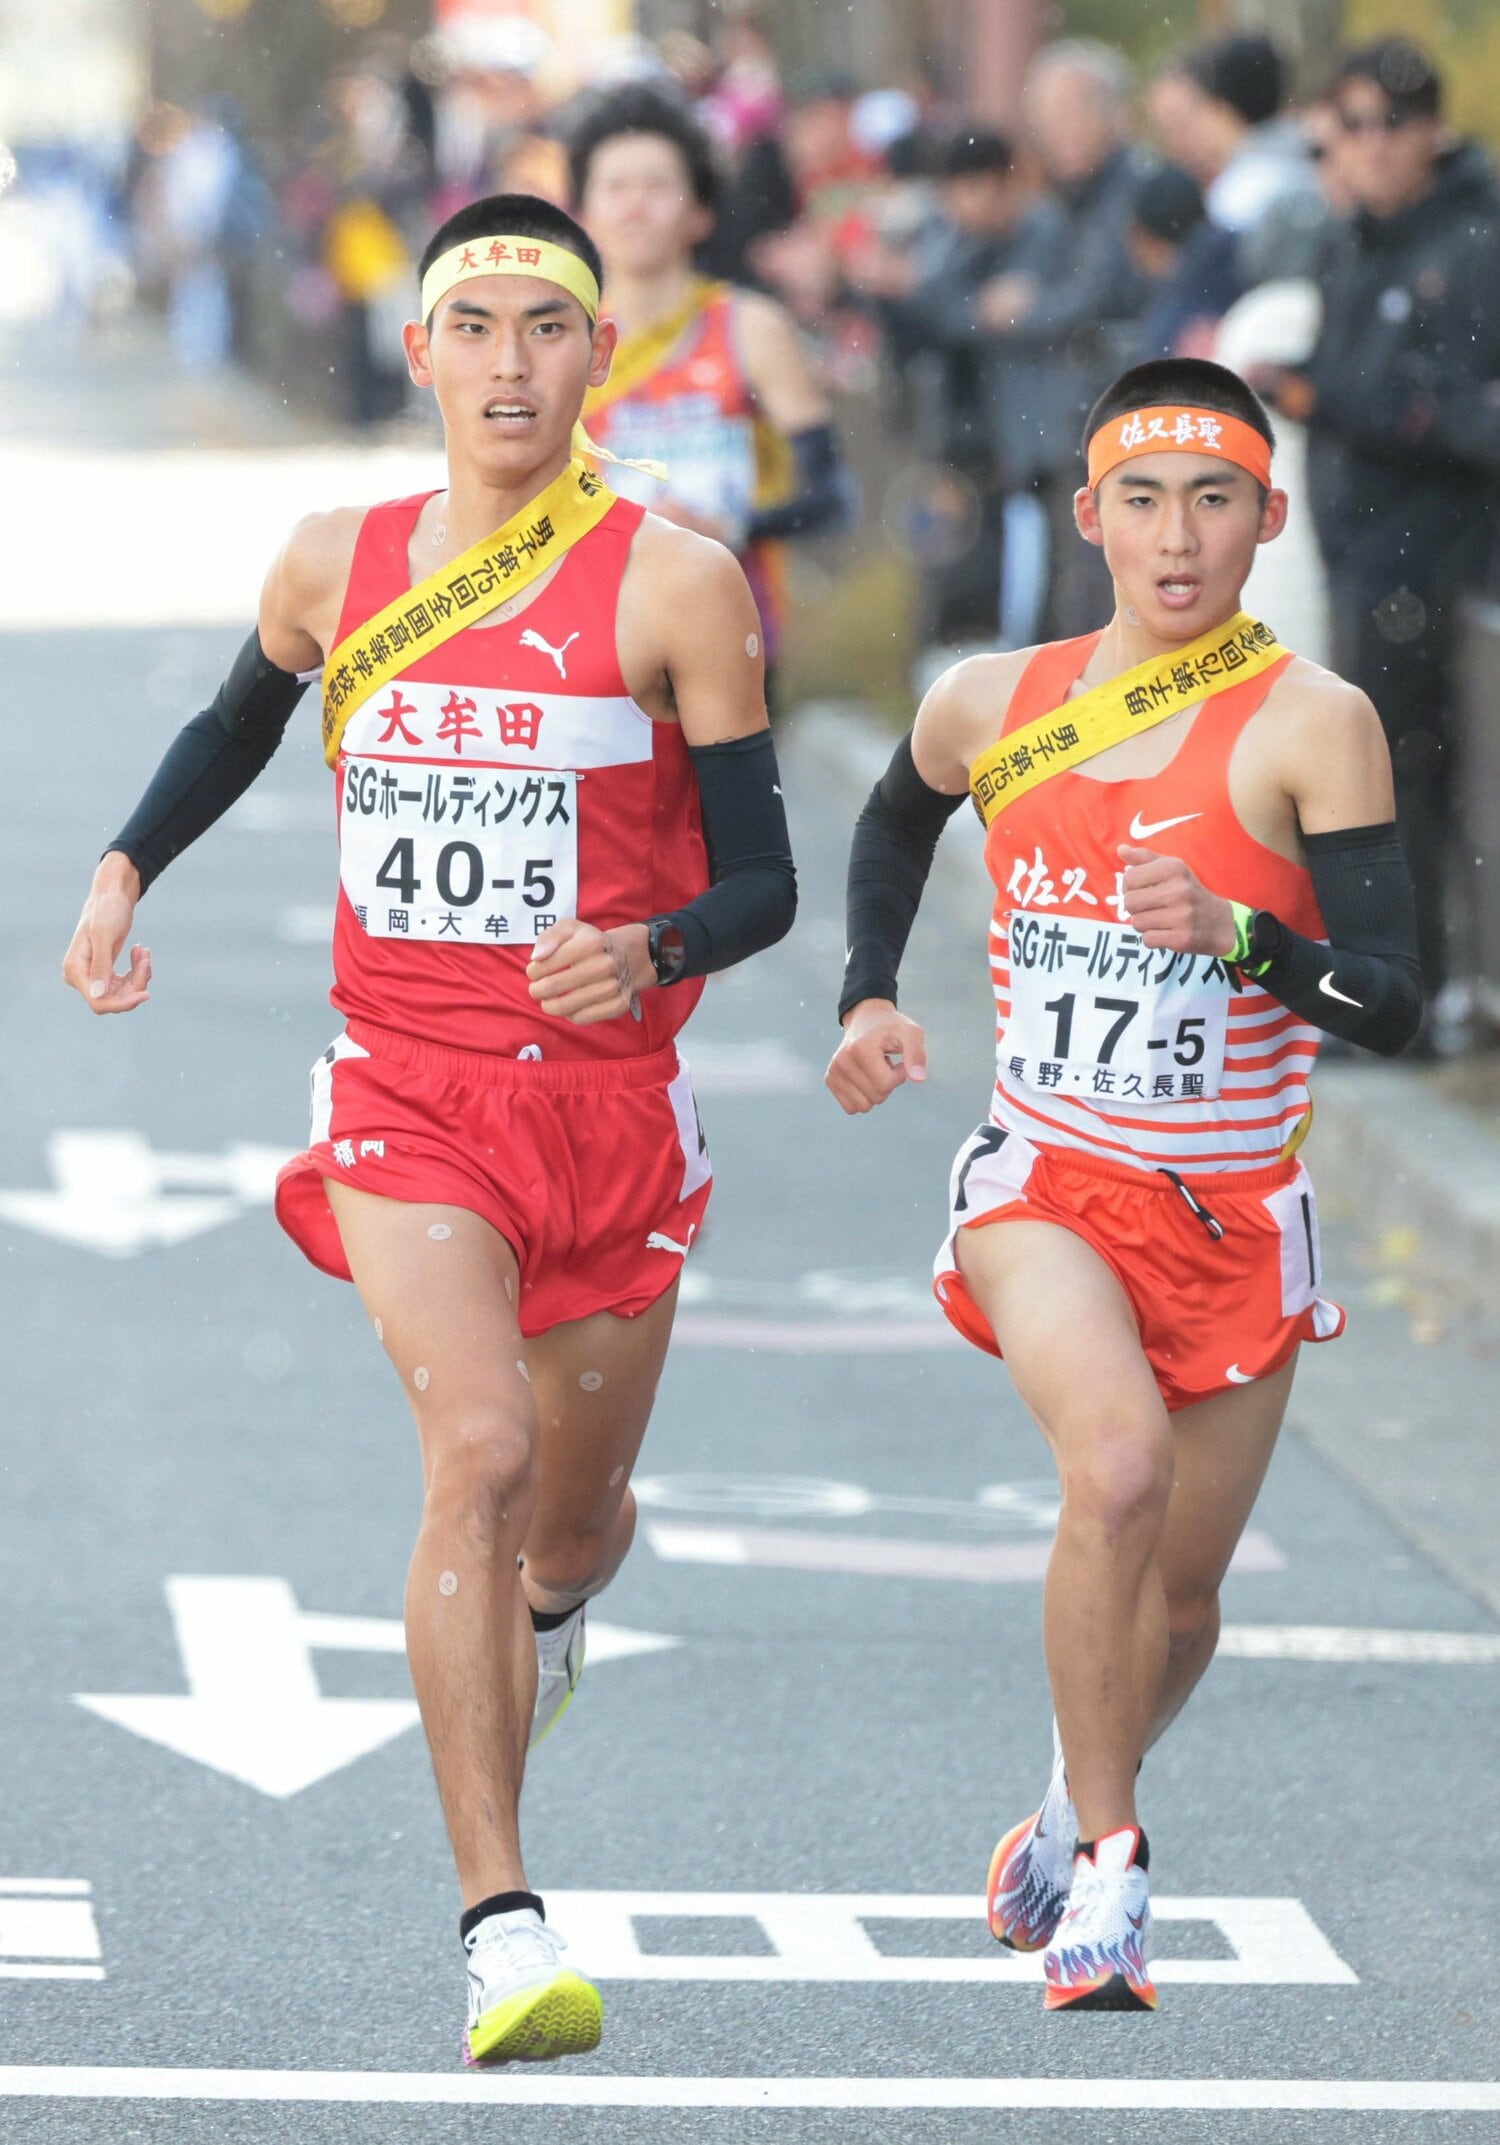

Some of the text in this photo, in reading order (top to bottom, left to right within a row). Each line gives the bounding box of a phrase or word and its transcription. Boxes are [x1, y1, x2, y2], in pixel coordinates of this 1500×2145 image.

[457, 240, 541, 273] 大牟田
[1119, 412, 1223, 450] 佐久長聖
[377, 690, 544, 754] 大牟田
[346, 765, 571, 827] SGホールディングス
[969, 723, 1080, 831] 男子第75回
[376, 838, 555, 908] 40-5
[1044, 992, 1206, 1067] 17-5
[1009, 1056, 1204, 1099] 長野・佐久長聖
